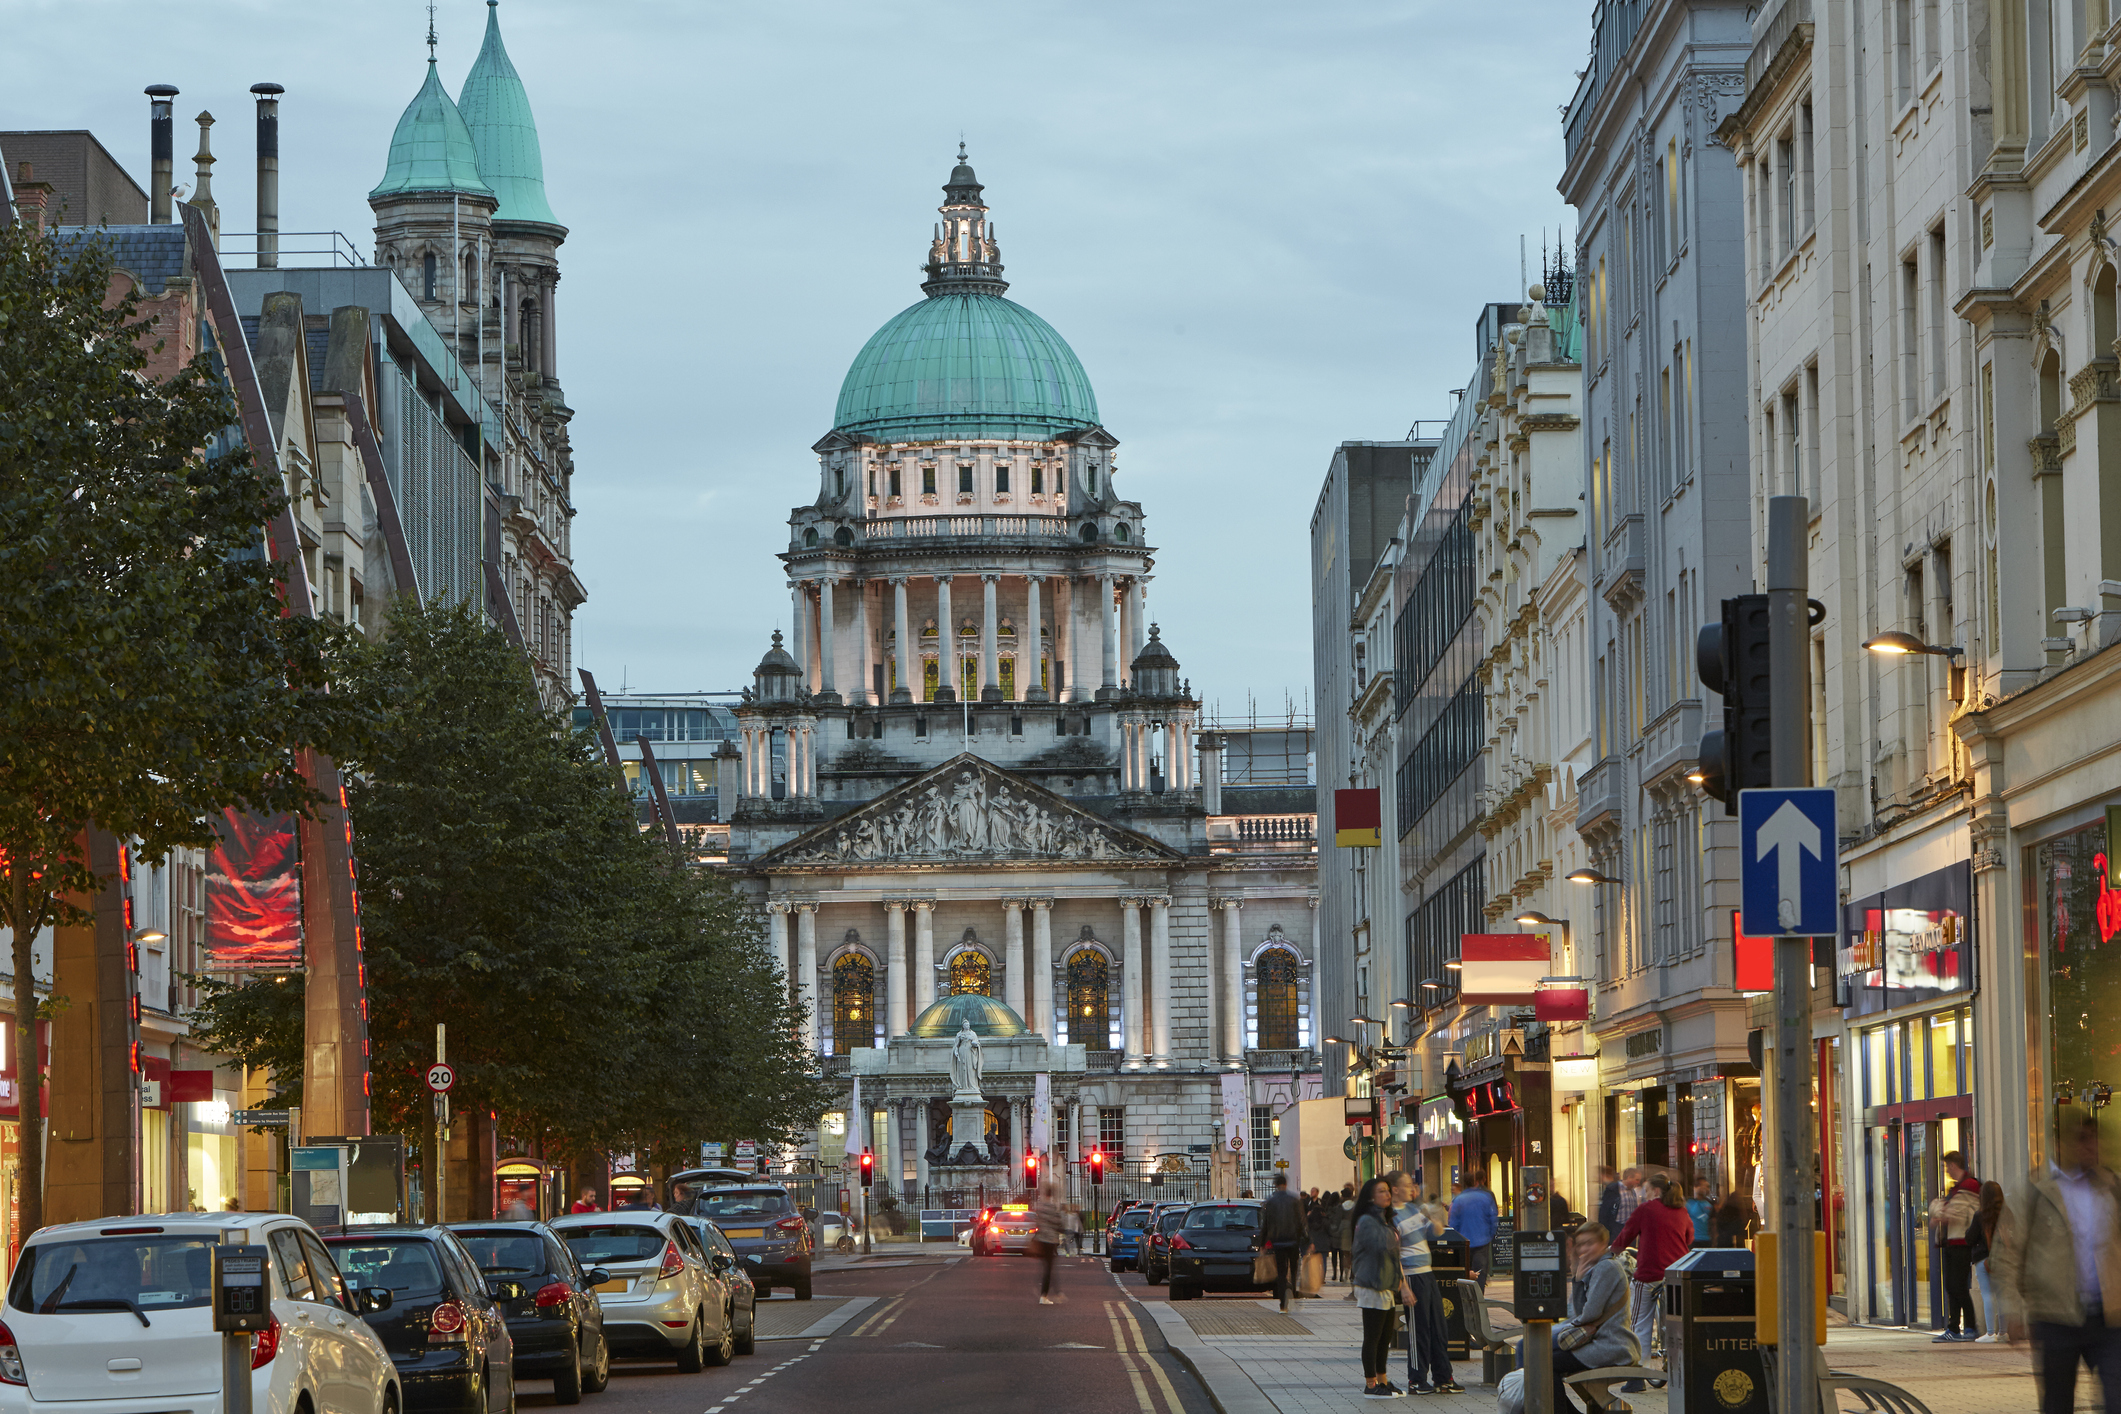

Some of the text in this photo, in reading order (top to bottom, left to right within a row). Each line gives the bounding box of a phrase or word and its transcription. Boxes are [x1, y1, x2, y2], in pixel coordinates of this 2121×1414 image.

[1560, 1065, 1591, 1074] NEW
[430, 1071, 451, 1084] 20
[1706, 1339, 1758, 1350] LITTER
